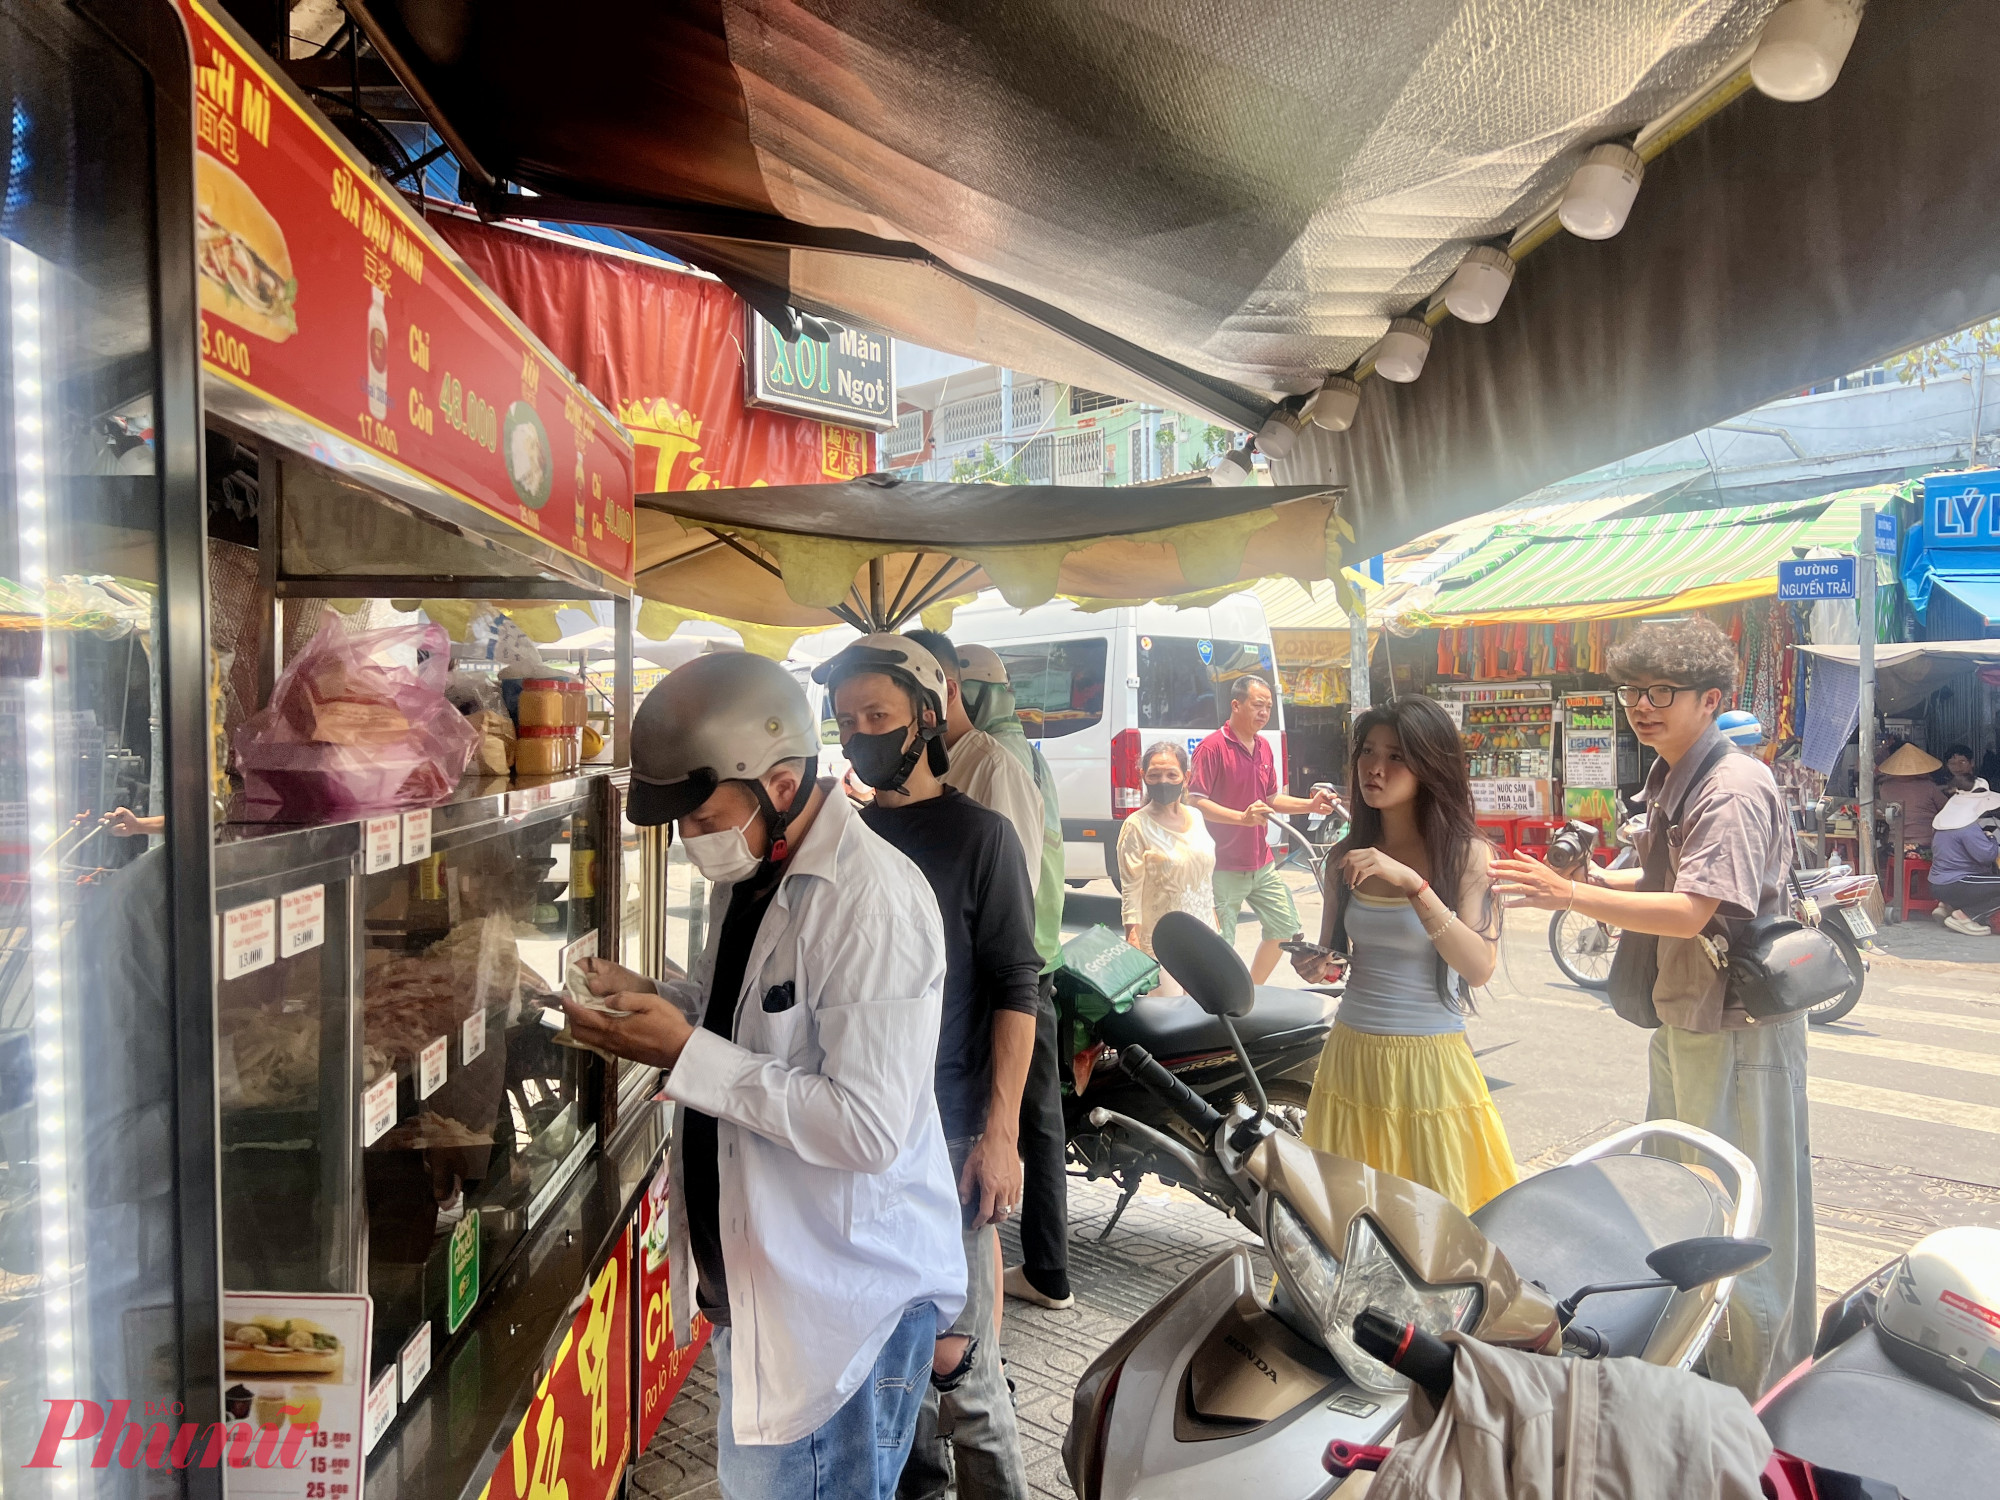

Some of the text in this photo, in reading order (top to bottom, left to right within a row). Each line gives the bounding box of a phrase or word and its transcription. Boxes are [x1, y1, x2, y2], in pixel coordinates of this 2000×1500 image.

[193, 47, 271, 149] NH MÌ
[330, 166, 424, 286] SỮA ĐẬU NÀNH
[409, 323, 430, 373] Chỉ
[839, 328, 881, 368] Mặn
[409, 386, 433, 436] Còn
[439, 371, 497, 454] 48.000
[837, 367, 885, 409] Ngọt
[357, 412, 399, 456] 17.000
[1934, 487, 1987, 537] LÝ
[1781, 578, 1851, 597] NGUYỄN TRÃI
[1794, 563, 1839, 576] ĐƯỜNG
[1496, 782, 1513, 793] NƯỚC
[1085, 941, 1132, 973] GrabFood
[1223, 1334, 1278, 1385] HONDA
[645, 1383, 658, 1418] Ra
[658, 1364, 667, 1395] lò
